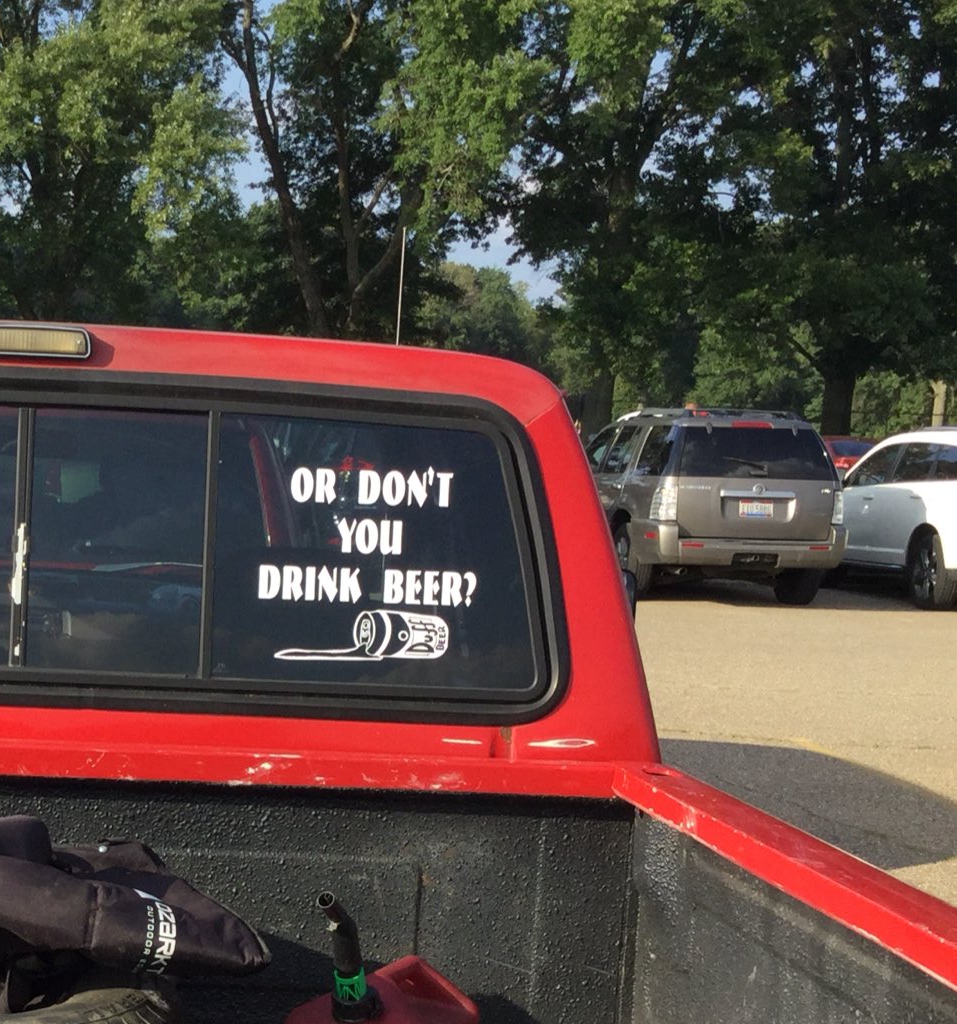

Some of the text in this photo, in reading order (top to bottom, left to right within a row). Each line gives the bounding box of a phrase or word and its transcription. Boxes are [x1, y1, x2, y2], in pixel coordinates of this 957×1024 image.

[291, 466, 454, 508] OR DON'T
[336, 517, 403, 555] YOU
[258, 564, 477, 608] DRINK BEER?
[435, 625, 446, 651] BEER
[143, 905, 154, 956] OUTDOOR
